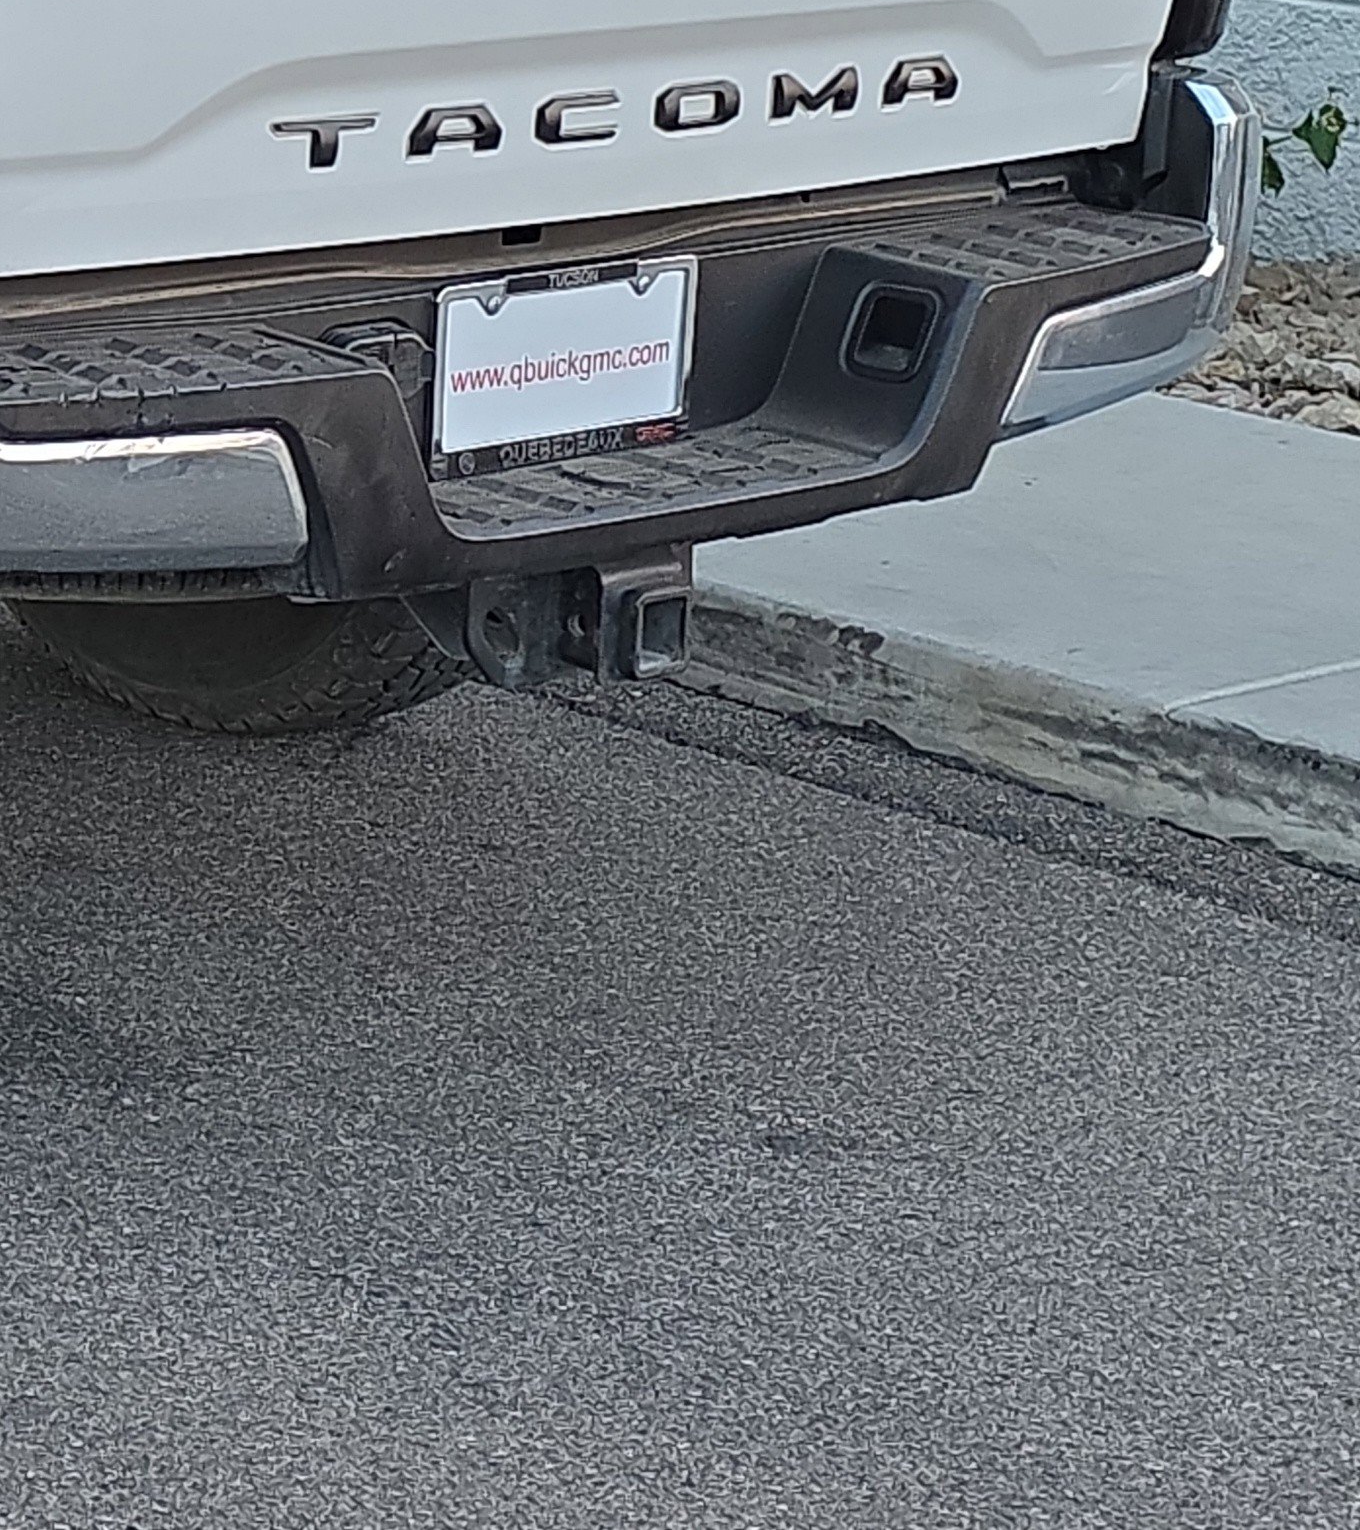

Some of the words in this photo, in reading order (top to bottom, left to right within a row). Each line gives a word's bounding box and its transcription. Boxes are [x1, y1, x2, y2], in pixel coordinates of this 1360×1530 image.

[267, 52, 961, 169] TACOMA
[547, 267, 601, 288] TUCSON
[449, 339, 671, 393] www.qbuickgmc.com
[498, 426, 625, 468] QUEBEDEAUX
